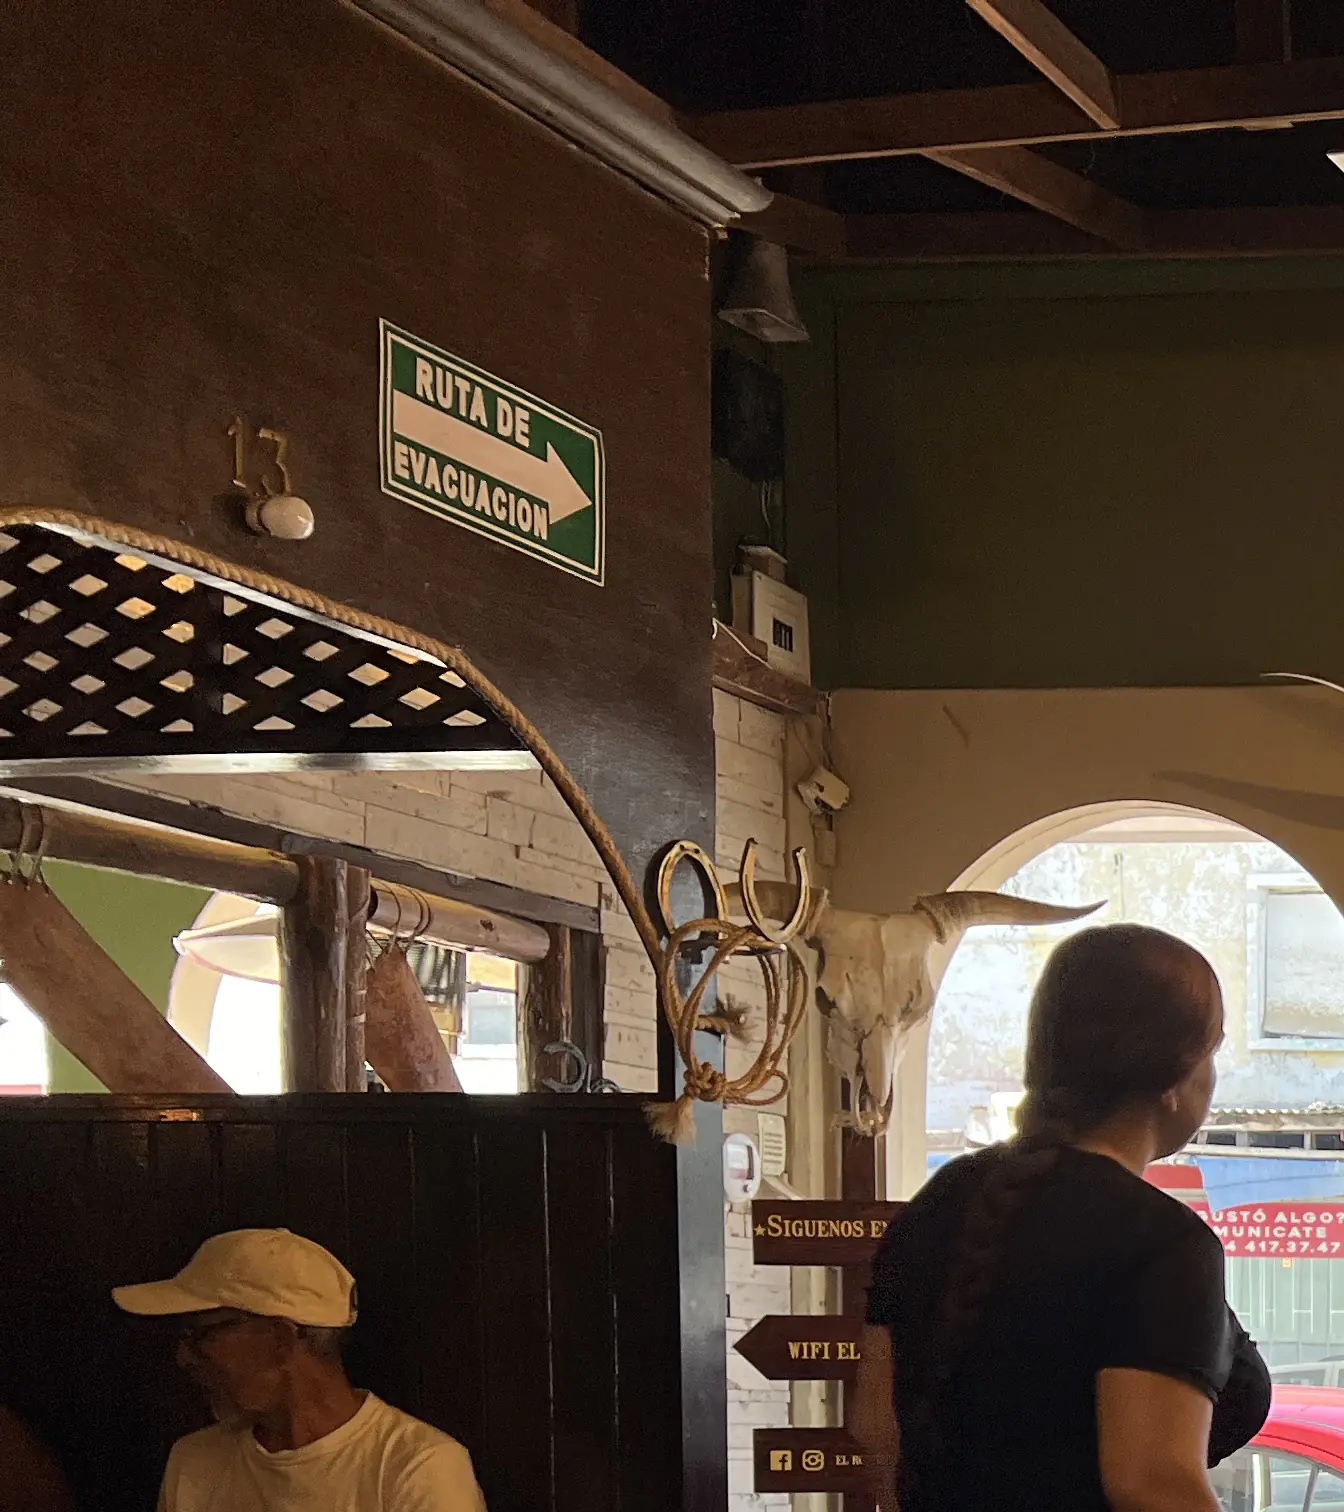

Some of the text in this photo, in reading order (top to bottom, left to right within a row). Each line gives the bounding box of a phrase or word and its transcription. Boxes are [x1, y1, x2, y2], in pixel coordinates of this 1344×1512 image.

[415, 356, 530, 448] RUTA DE
[394, 440, 548, 541] EVACUACION
[1212, 1225, 1327, 1238] MUNICATE
[1244, 1240, 1341, 1254] 417.37.47
[788, 1341, 861, 1360] WIFI EL
[835, 1455, 850, 1466] EL
